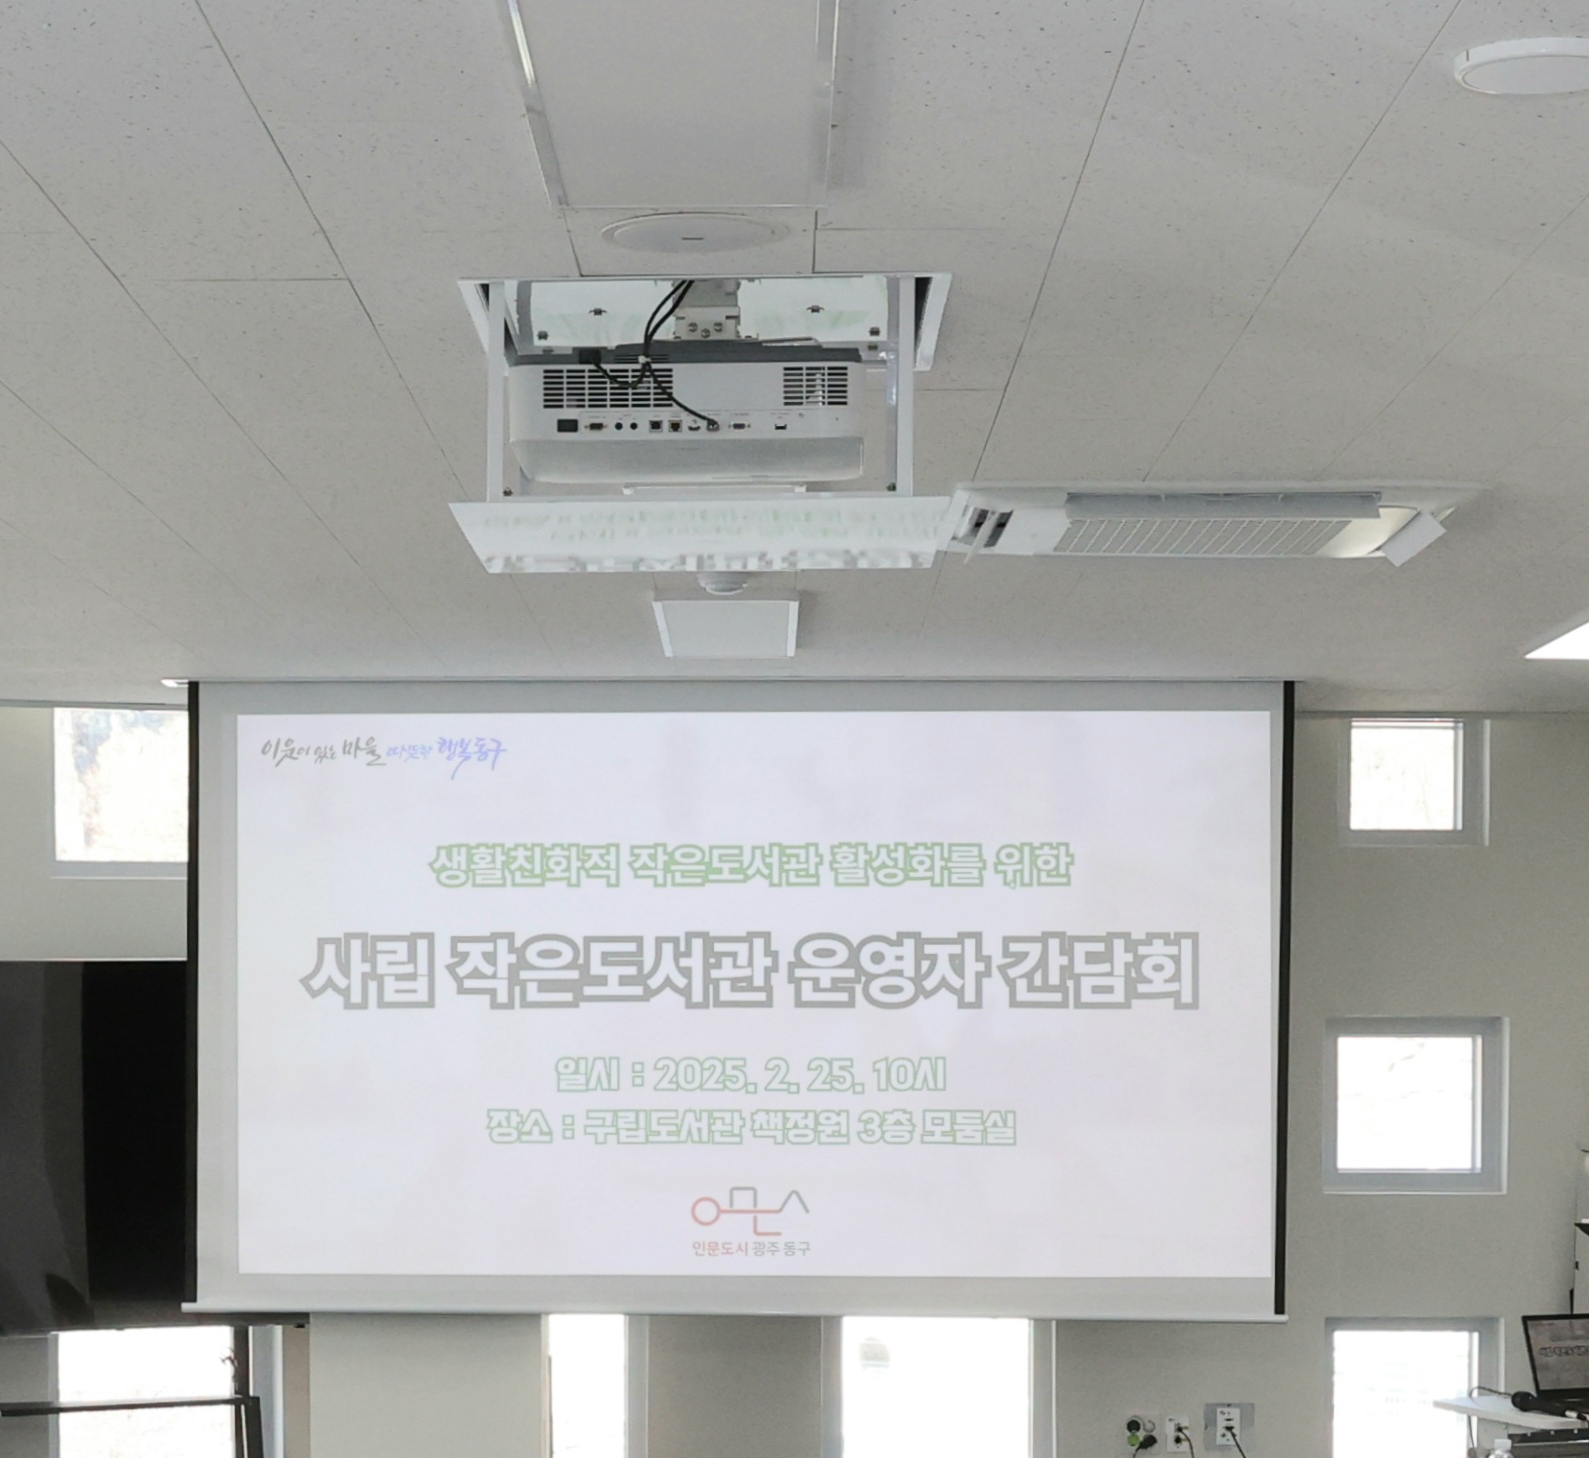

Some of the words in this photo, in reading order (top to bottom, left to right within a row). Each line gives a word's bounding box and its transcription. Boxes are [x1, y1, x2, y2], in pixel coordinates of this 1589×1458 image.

[342, 736, 387, 766] 마을
[436, 736, 508, 780] 행복동구
[428, 842, 621, 888] 생활친화적
[627, 842, 823, 888] 작은도서관
[829, 842, 987, 888] 활성화를
[993, 842, 1075, 889] 위한
[299, 932, 435, 1010] 사립
[445, 931, 780, 1010] 작은도서관
[787, 931, 992, 1010] 운영자
[996, 931, 1200, 1010] 간담회
[555, 1056, 620, 1092] 일시
[873, 1056, 946, 1092] 10시
[486, 1108, 553, 1144] 장소
[584, 1109, 746, 1145] 구립도서관
[750, 1109, 850, 1145] 책정원
[857, 1109, 916, 1145] 3층
[920, 1109, 1017, 1146] 모둠실
[692, 1241, 748, 1257] 인문도시
[752, 1241, 780, 1257] 광주
[783, 1241, 811, 1257] 동구
